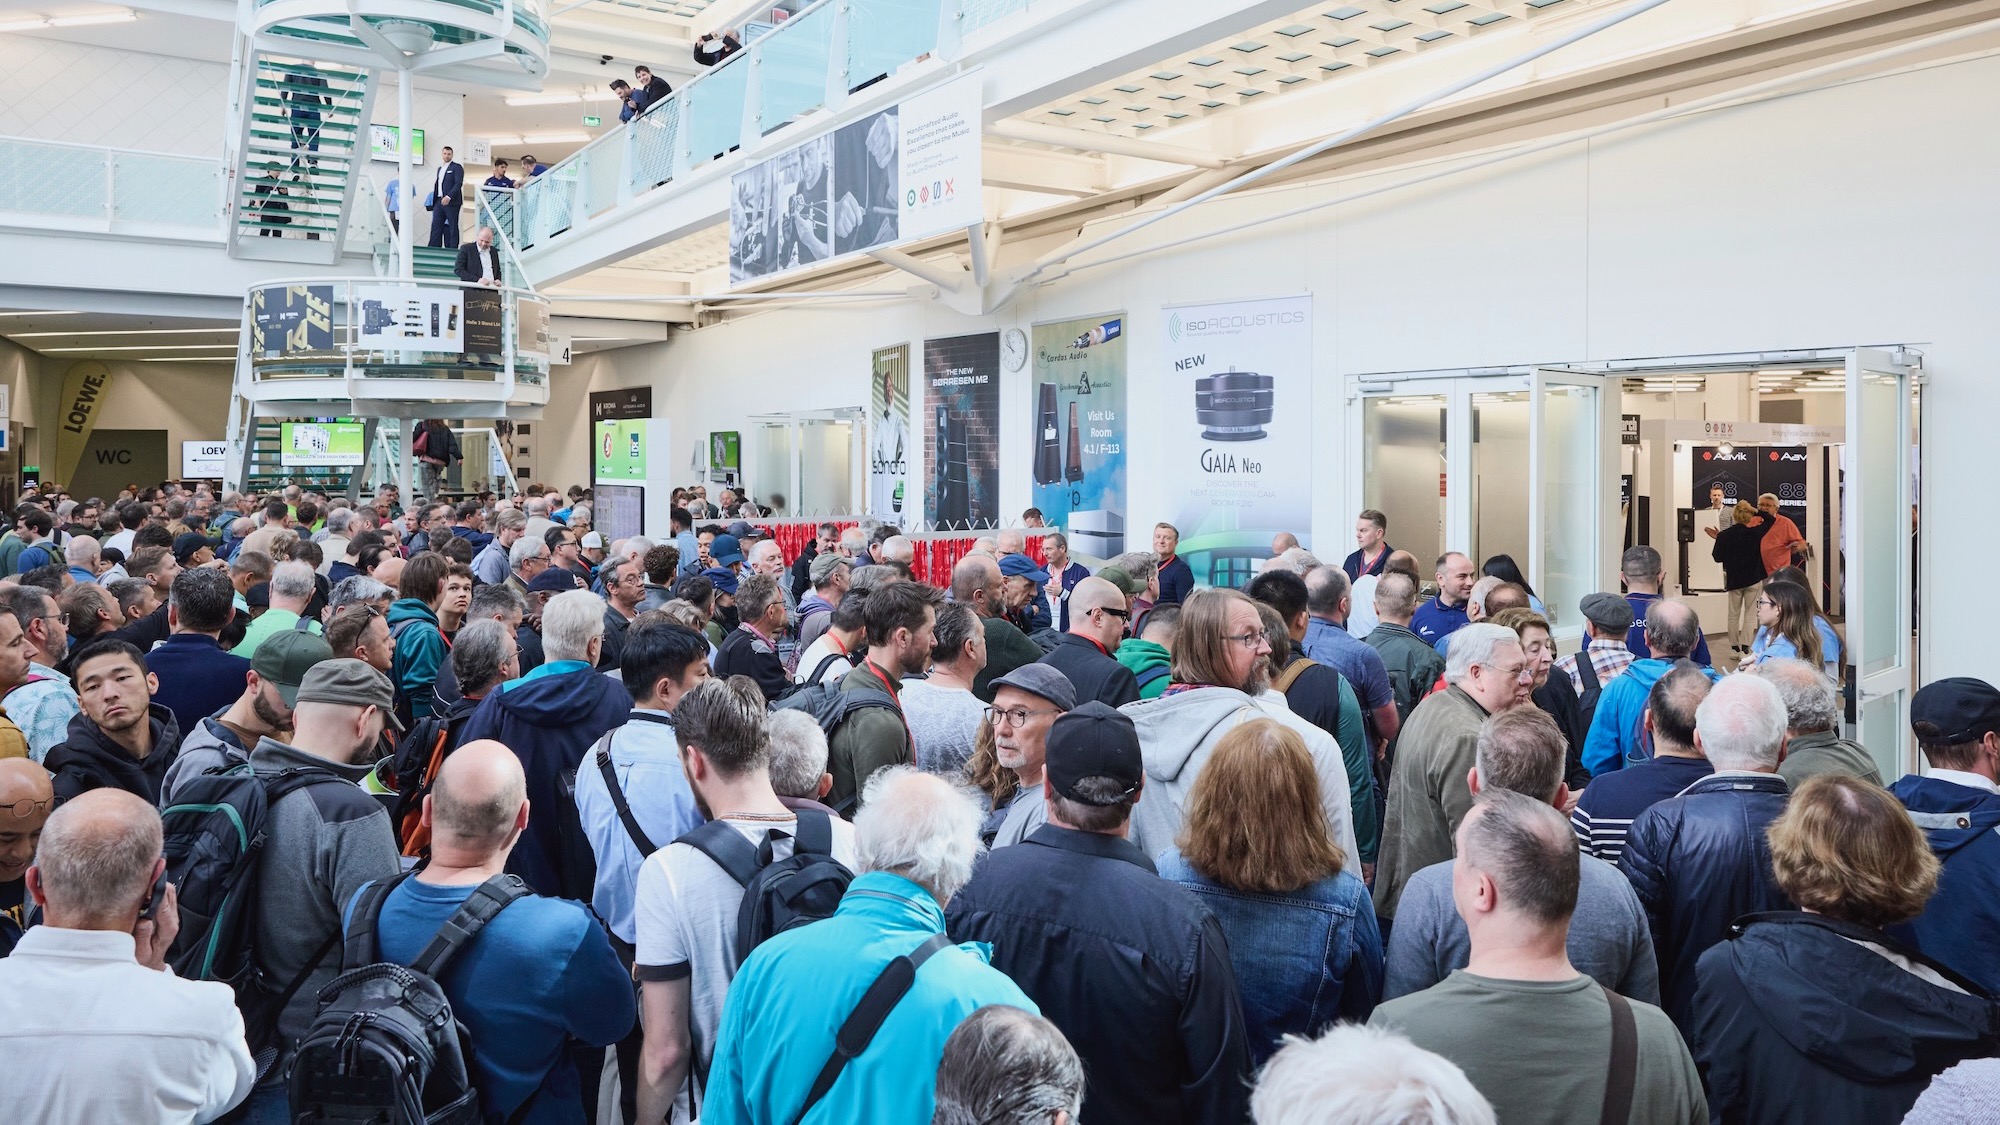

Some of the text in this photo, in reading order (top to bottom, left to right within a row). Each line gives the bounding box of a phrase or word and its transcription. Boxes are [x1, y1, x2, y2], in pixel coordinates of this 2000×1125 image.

[951, 128, 970, 138] Music
[563, 347, 570, 362] 4
[1047, 351, 1088, 362] Cardas Audio
[1175, 354, 1206, 371] NEW
[946, 367, 973, 376] THE NEW
[975, 375, 989, 384] M2
[1087, 410, 1115, 421] Visit Us
[1090, 428, 1112, 437] Room
[1084, 444, 1095, 454] 4.1
[1100, 444, 1120, 454] F-113
[96, 450, 131, 465] WC
[1200, 448, 1262, 473] GAIA Neo
[1206, 480, 1242, 488] DISCOVER
[1779, 482, 1807, 498] 88
